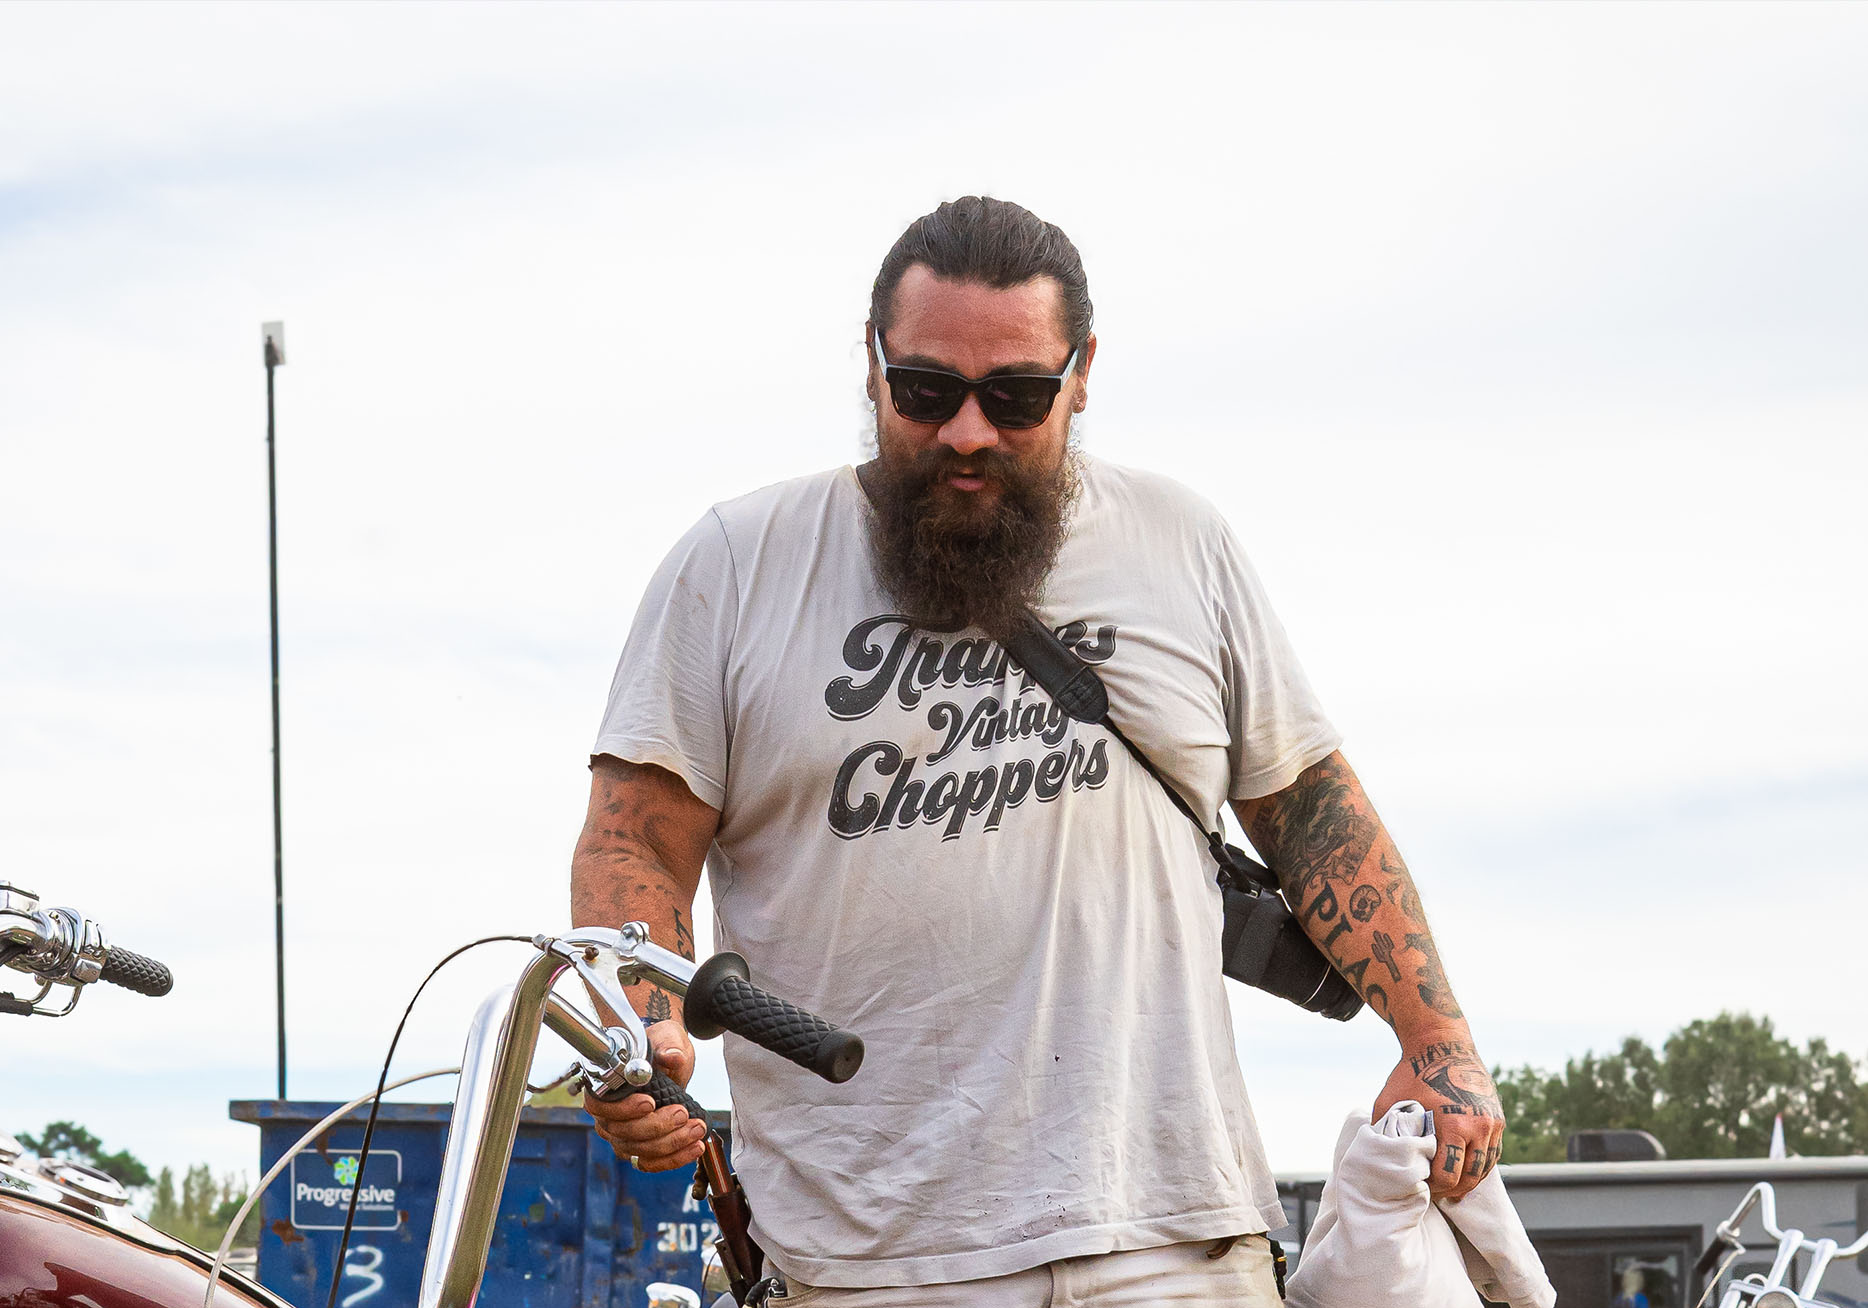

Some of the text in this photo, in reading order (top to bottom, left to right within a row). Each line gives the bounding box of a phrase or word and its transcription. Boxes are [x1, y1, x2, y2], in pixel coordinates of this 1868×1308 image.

[926, 696, 1078, 766] Vintag
[828, 740, 1110, 843] Choppers
[1304, 881, 1397, 1028] PLAC
[341, 1245, 383, 1308] 3
